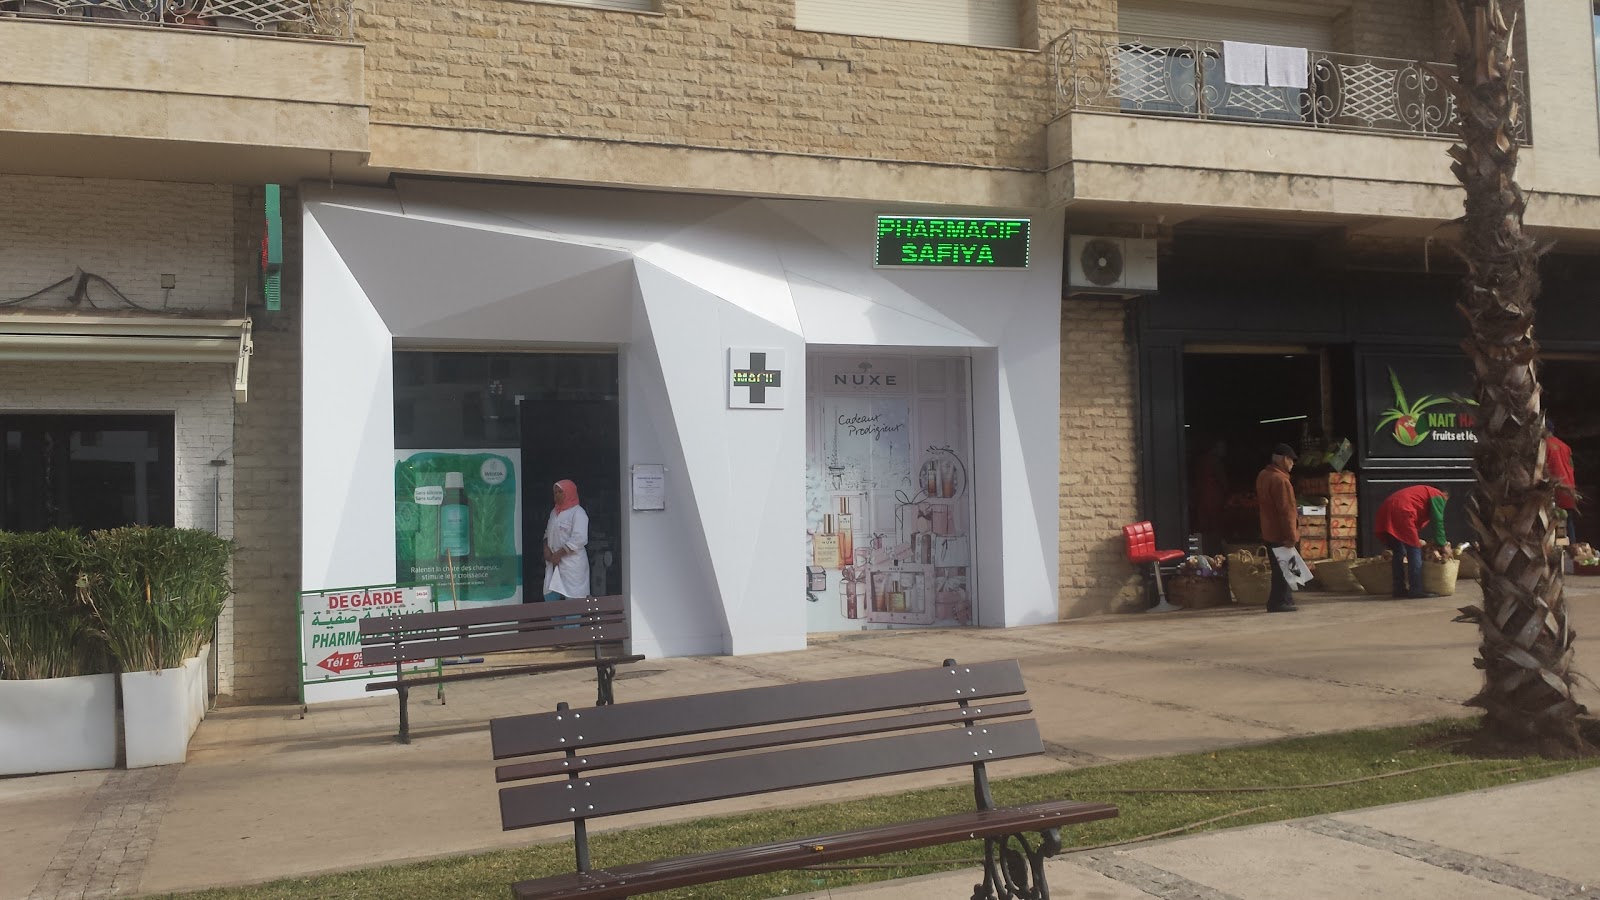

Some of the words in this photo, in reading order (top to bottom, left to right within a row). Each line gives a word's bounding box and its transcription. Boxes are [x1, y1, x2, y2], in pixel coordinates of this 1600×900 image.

[901, 242, 995, 264] SAFIYA
[834, 374, 897, 386] NUXE
[838, 413, 883, 426] Cadeaux
[1428, 413, 1457, 428] NAIT
[1459, 413, 1475, 428] HA
[848, 423, 904, 441] Prodigieux
[1432, 430, 1456, 441] fruits
[1456, 431, 1465, 441] et
[328, 594, 349, 610] DE
[350, 591, 404, 608] GARDE
[311, 611, 357, 630] صفية
[311, 630, 362, 649] PHARMA
[326, 657, 344, 668] Tél
[352, 652, 363, 661] 05
